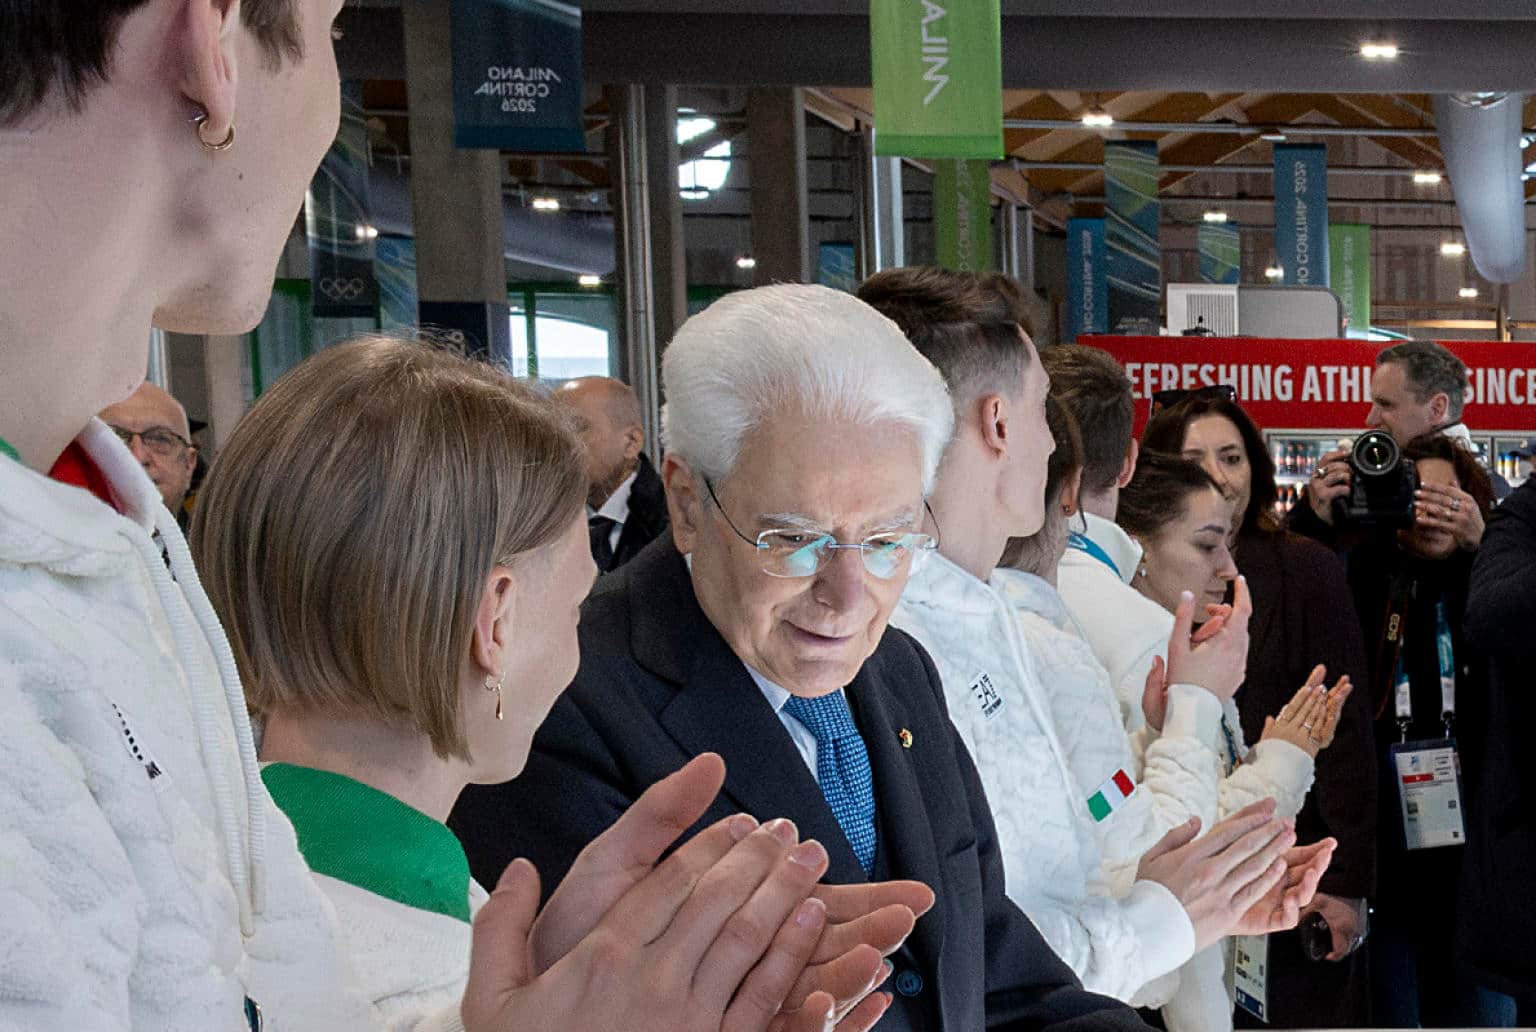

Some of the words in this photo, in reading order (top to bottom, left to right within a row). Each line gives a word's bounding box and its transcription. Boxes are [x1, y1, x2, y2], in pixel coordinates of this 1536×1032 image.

[1124, 363, 1293, 401] EFRESHING
[1301, 365, 1373, 402] ATHL
[1387, 613, 1400, 641] EOS
